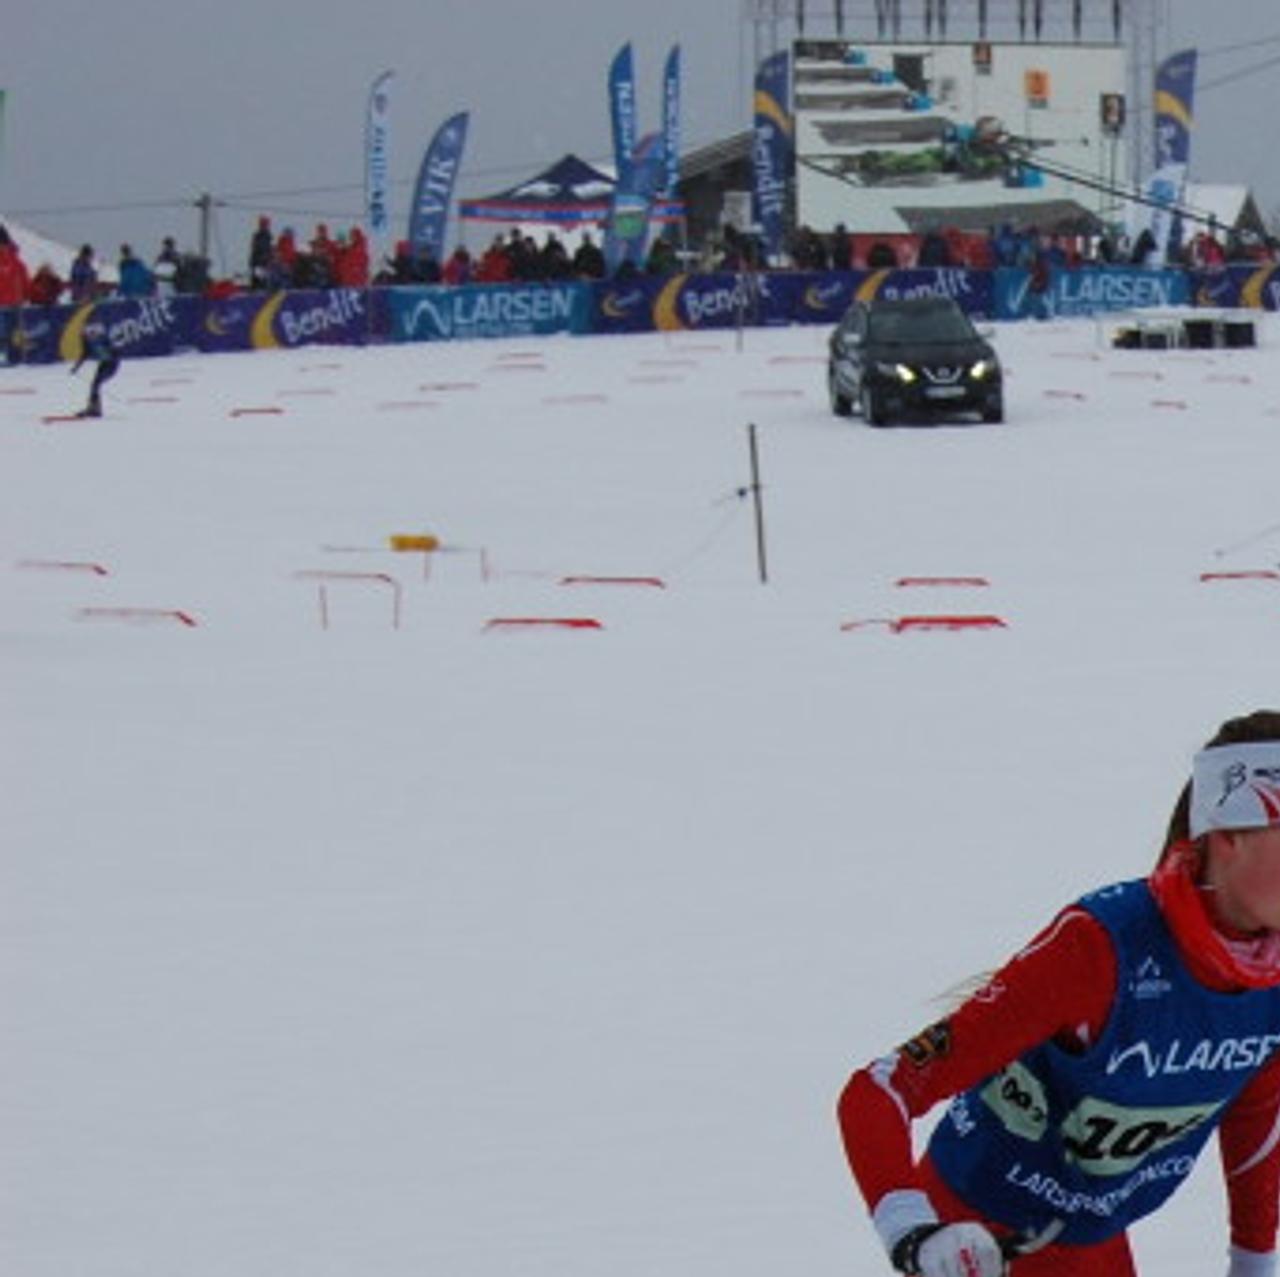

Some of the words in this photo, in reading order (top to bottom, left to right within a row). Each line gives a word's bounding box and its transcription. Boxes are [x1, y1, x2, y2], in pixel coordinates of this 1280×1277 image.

[453, 288, 576, 324] LARSEN
[1060, 273, 1170, 306] LARSEN
[88, 297, 174, 348] endit
[281, 286, 364, 343] Bendit
[1065, 1115, 1205, 1160] 10
